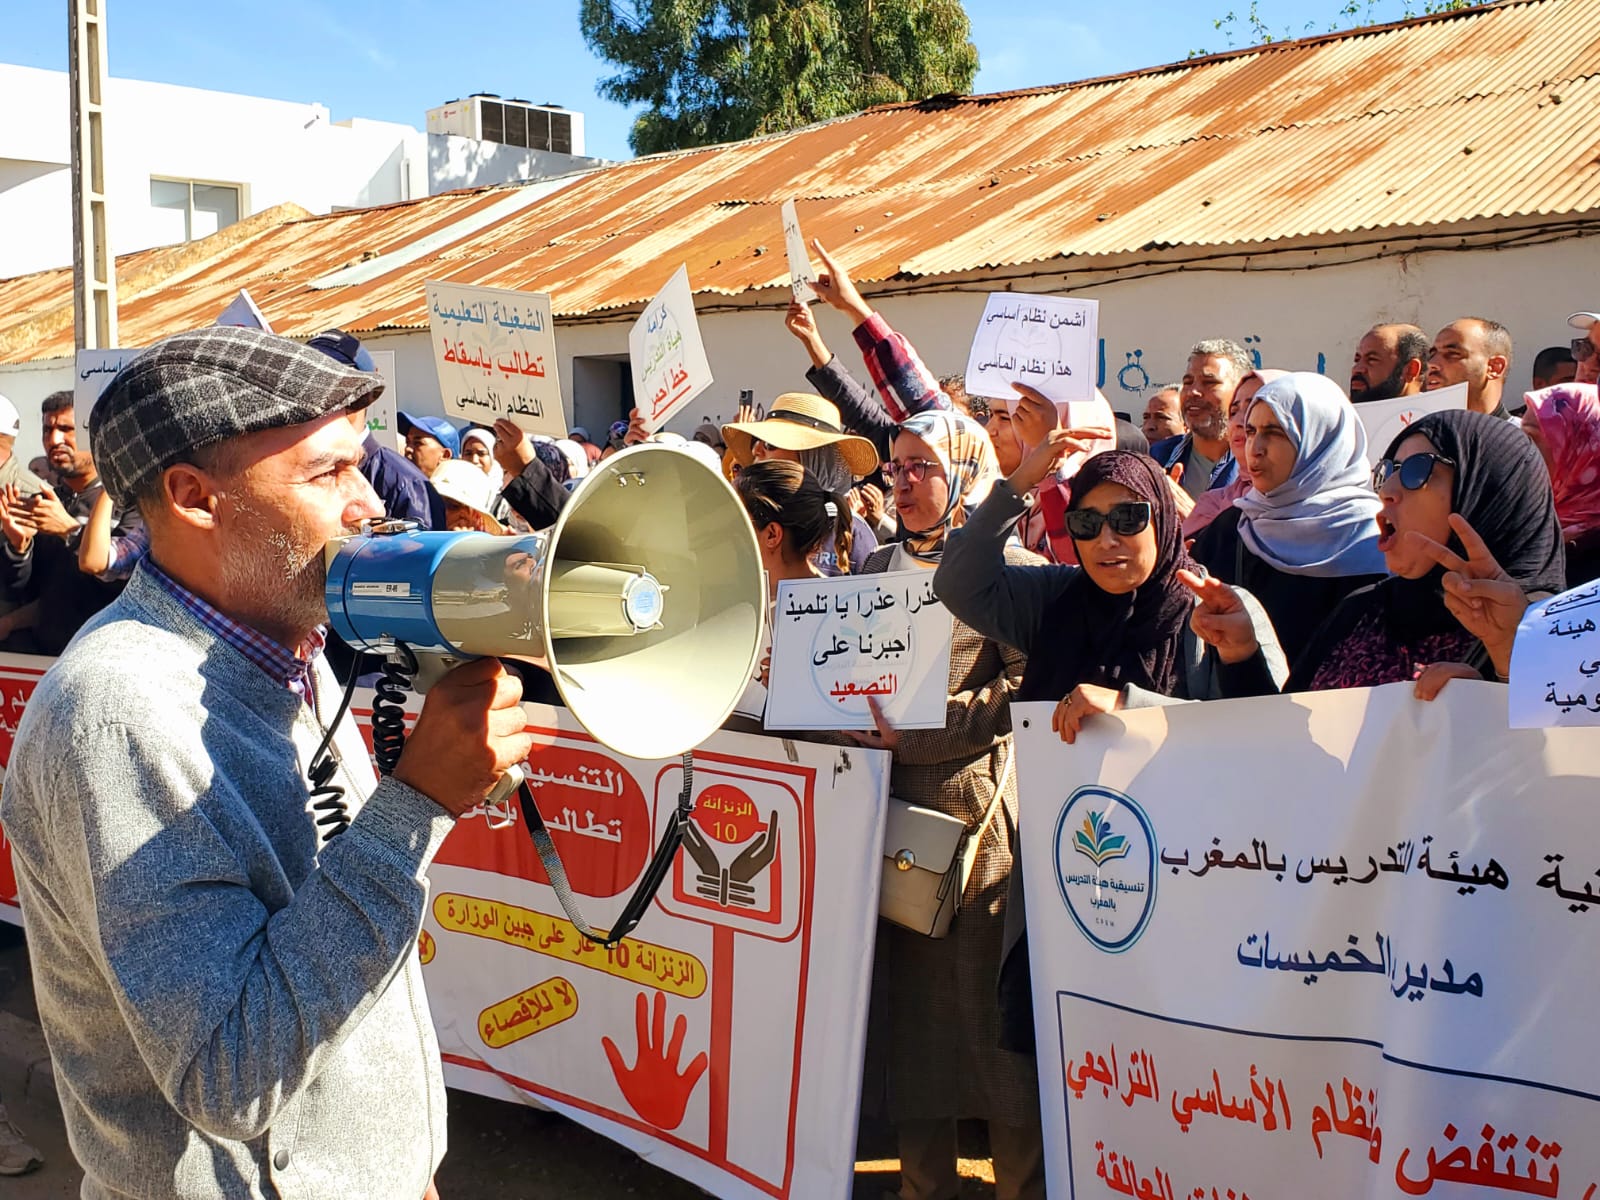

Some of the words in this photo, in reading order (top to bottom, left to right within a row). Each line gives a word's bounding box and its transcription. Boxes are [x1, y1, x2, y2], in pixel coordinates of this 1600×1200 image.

[433, 293, 488, 326] التعليمية
[493, 301, 545, 335] الشغيلة
[986, 304, 1021, 325] أساسي
[1021, 307, 1047, 328] نظام
[1049, 310, 1086, 329] أشمن
[443, 337, 492, 376] بإسقاط
[497, 350, 545, 380] تطالب
[1019, 358, 1046, 377] نظام
[1051, 360, 1072, 376] هذا
[672, 362, 689, 390] خط
[456, 386, 502, 411] الأساسي
[507, 395, 544, 419] النظام
[651, 371, 670, 416] أحمر
[786, 593, 828, 622] تلميذ
[835, 594, 849, 618] يا
[857, 587, 895, 617] عذرا
[813, 634, 850, 666] على
[859, 625, 912, 660] أجبرنا
[830, 672, 898, 703] التصعيد
[703, 794, 753, 816] الزنزانة
[713, 821, 738, 842] 10
[1160, 836, 1287, 882] بالمغرب
[1416, 834, 1510, 896] هيئة
[446, 898, 499, 931] الوزارة
[503, 914, 536, 943] جبين
[538, 922, 566, 949] على
[635, 944, 695, 987] الزنزانة
[1237, 930, 1391, 986] الخميسات
[553, 980, 573, 1006] لا
[484, 989, 555, 1042] للإقصاء
[1066, 1042, 1160, 1108] التراجعي
[1171, 1063, 1292, 1134] الأساسي
[1394, 1122, 1563, 1200] تنتفض
